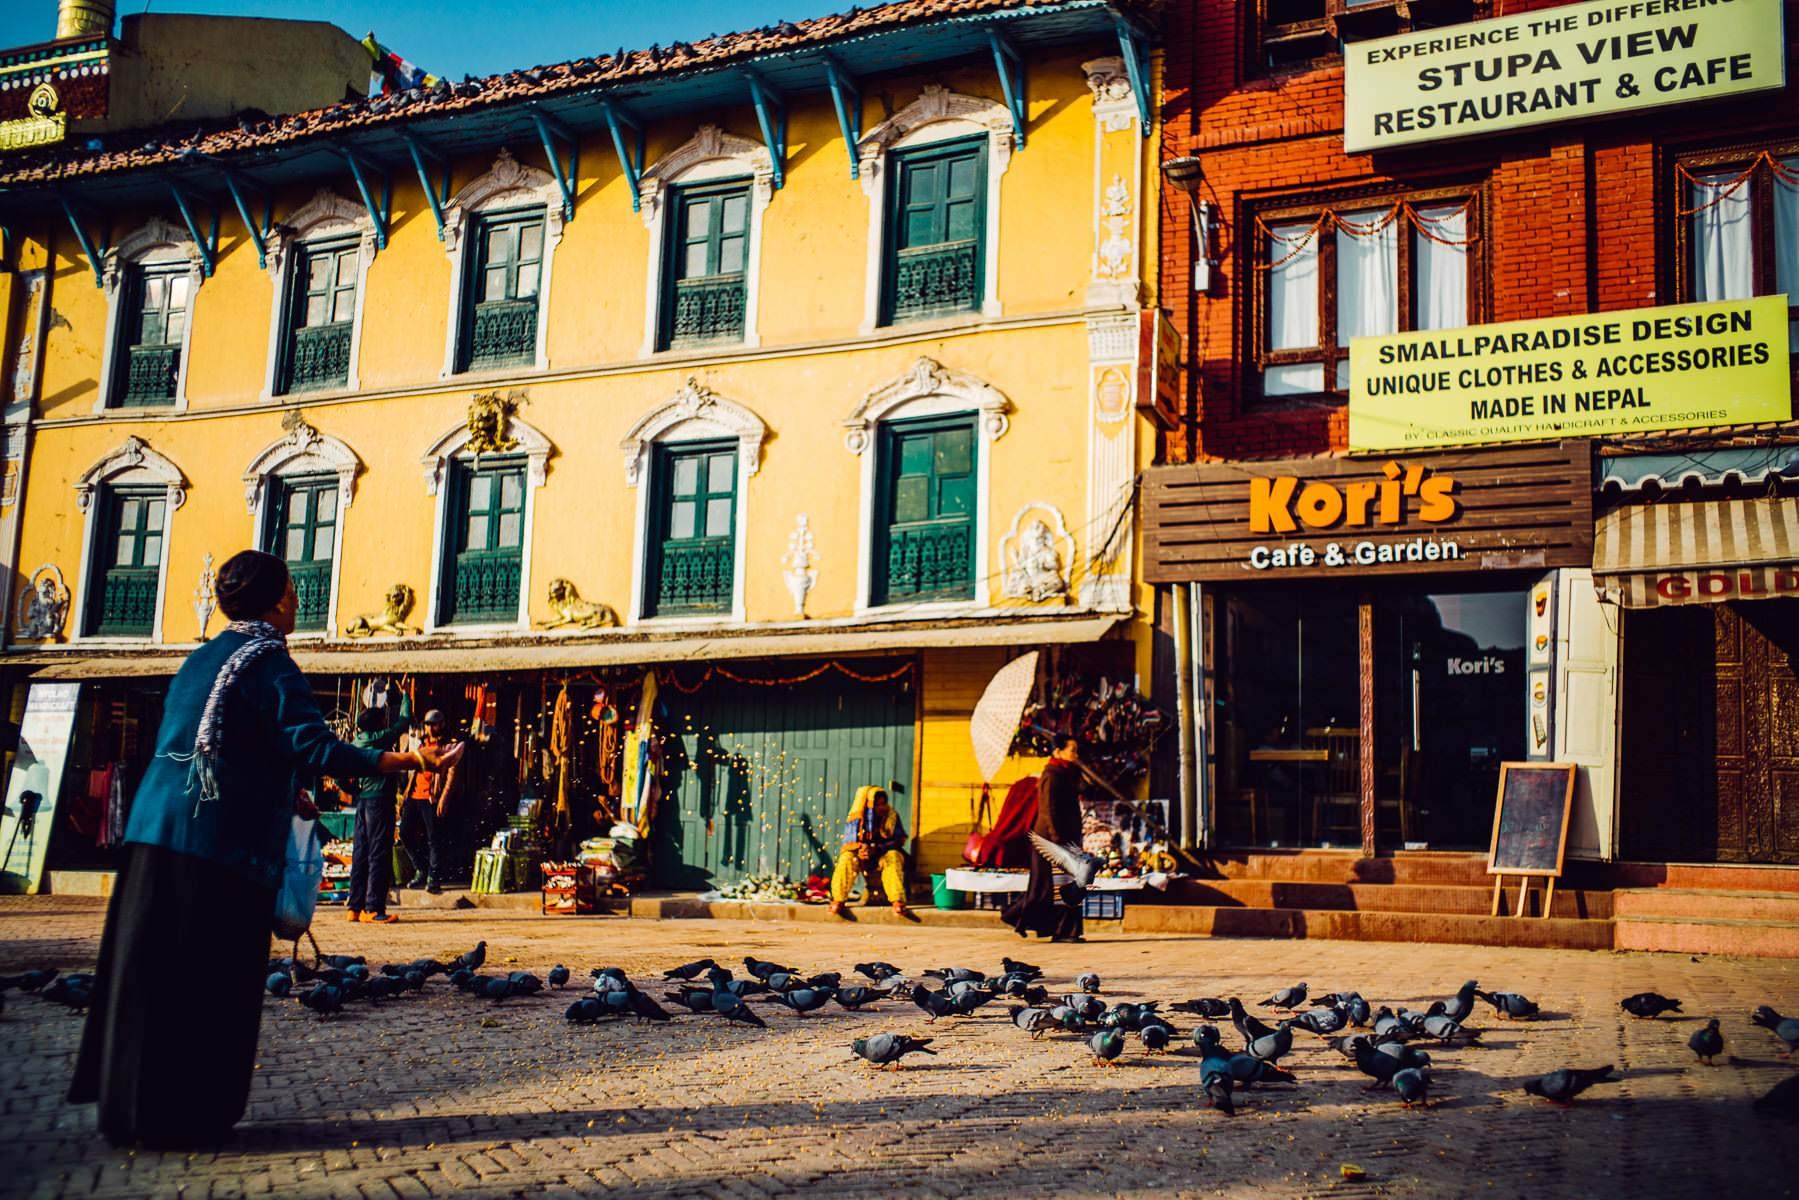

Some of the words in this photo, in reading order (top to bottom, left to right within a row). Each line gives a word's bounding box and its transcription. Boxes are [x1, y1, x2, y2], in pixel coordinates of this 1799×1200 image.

[1367, 26, 1520, 65] EXPERIENCE
[1527, 16, 1578, 37] THE
[1587, 0, 1736, 27] DIFFEREN
[1417, 49, 1562, 92] STUPA
[1576, 23, 1698, 65] VIEW
[1374, 78, 1602, 136] RESTAURANT
[1615, 72, 1640, 99] &
[1654, 53, 1753, 93] CAFE
[1378, 323, 1621, 364] SMALLPARADISE
[1632, 310, 1752, 342] DESIGN
[1367, 371, 1451, 396] UNIQUE
[1458, 361, 1563, 389] CLOTHES
[1571, 359, 1588, 380] &
[1596, 342, 1770, 379] ACCESSORIES
[1426, 427, 1477, 440] CLASSIC
[1480, 423, 1532, 436] QUALITY
[1619, 417, 1629, 425] &
[1632, 409, 1728, 425] ACCESSORIES
[1471, 396, 1535, 420] MADE
[1543, 393, 1566, 415] IN
[1575, 387, 1652, 412] NEPAL
[1249, 459, 1456, 533] Kori's
[1324, 542, 1345, 567] &
[1656, 569, 1799, 600] GOLD
[1447, 656, 1505, 676] Kori's
